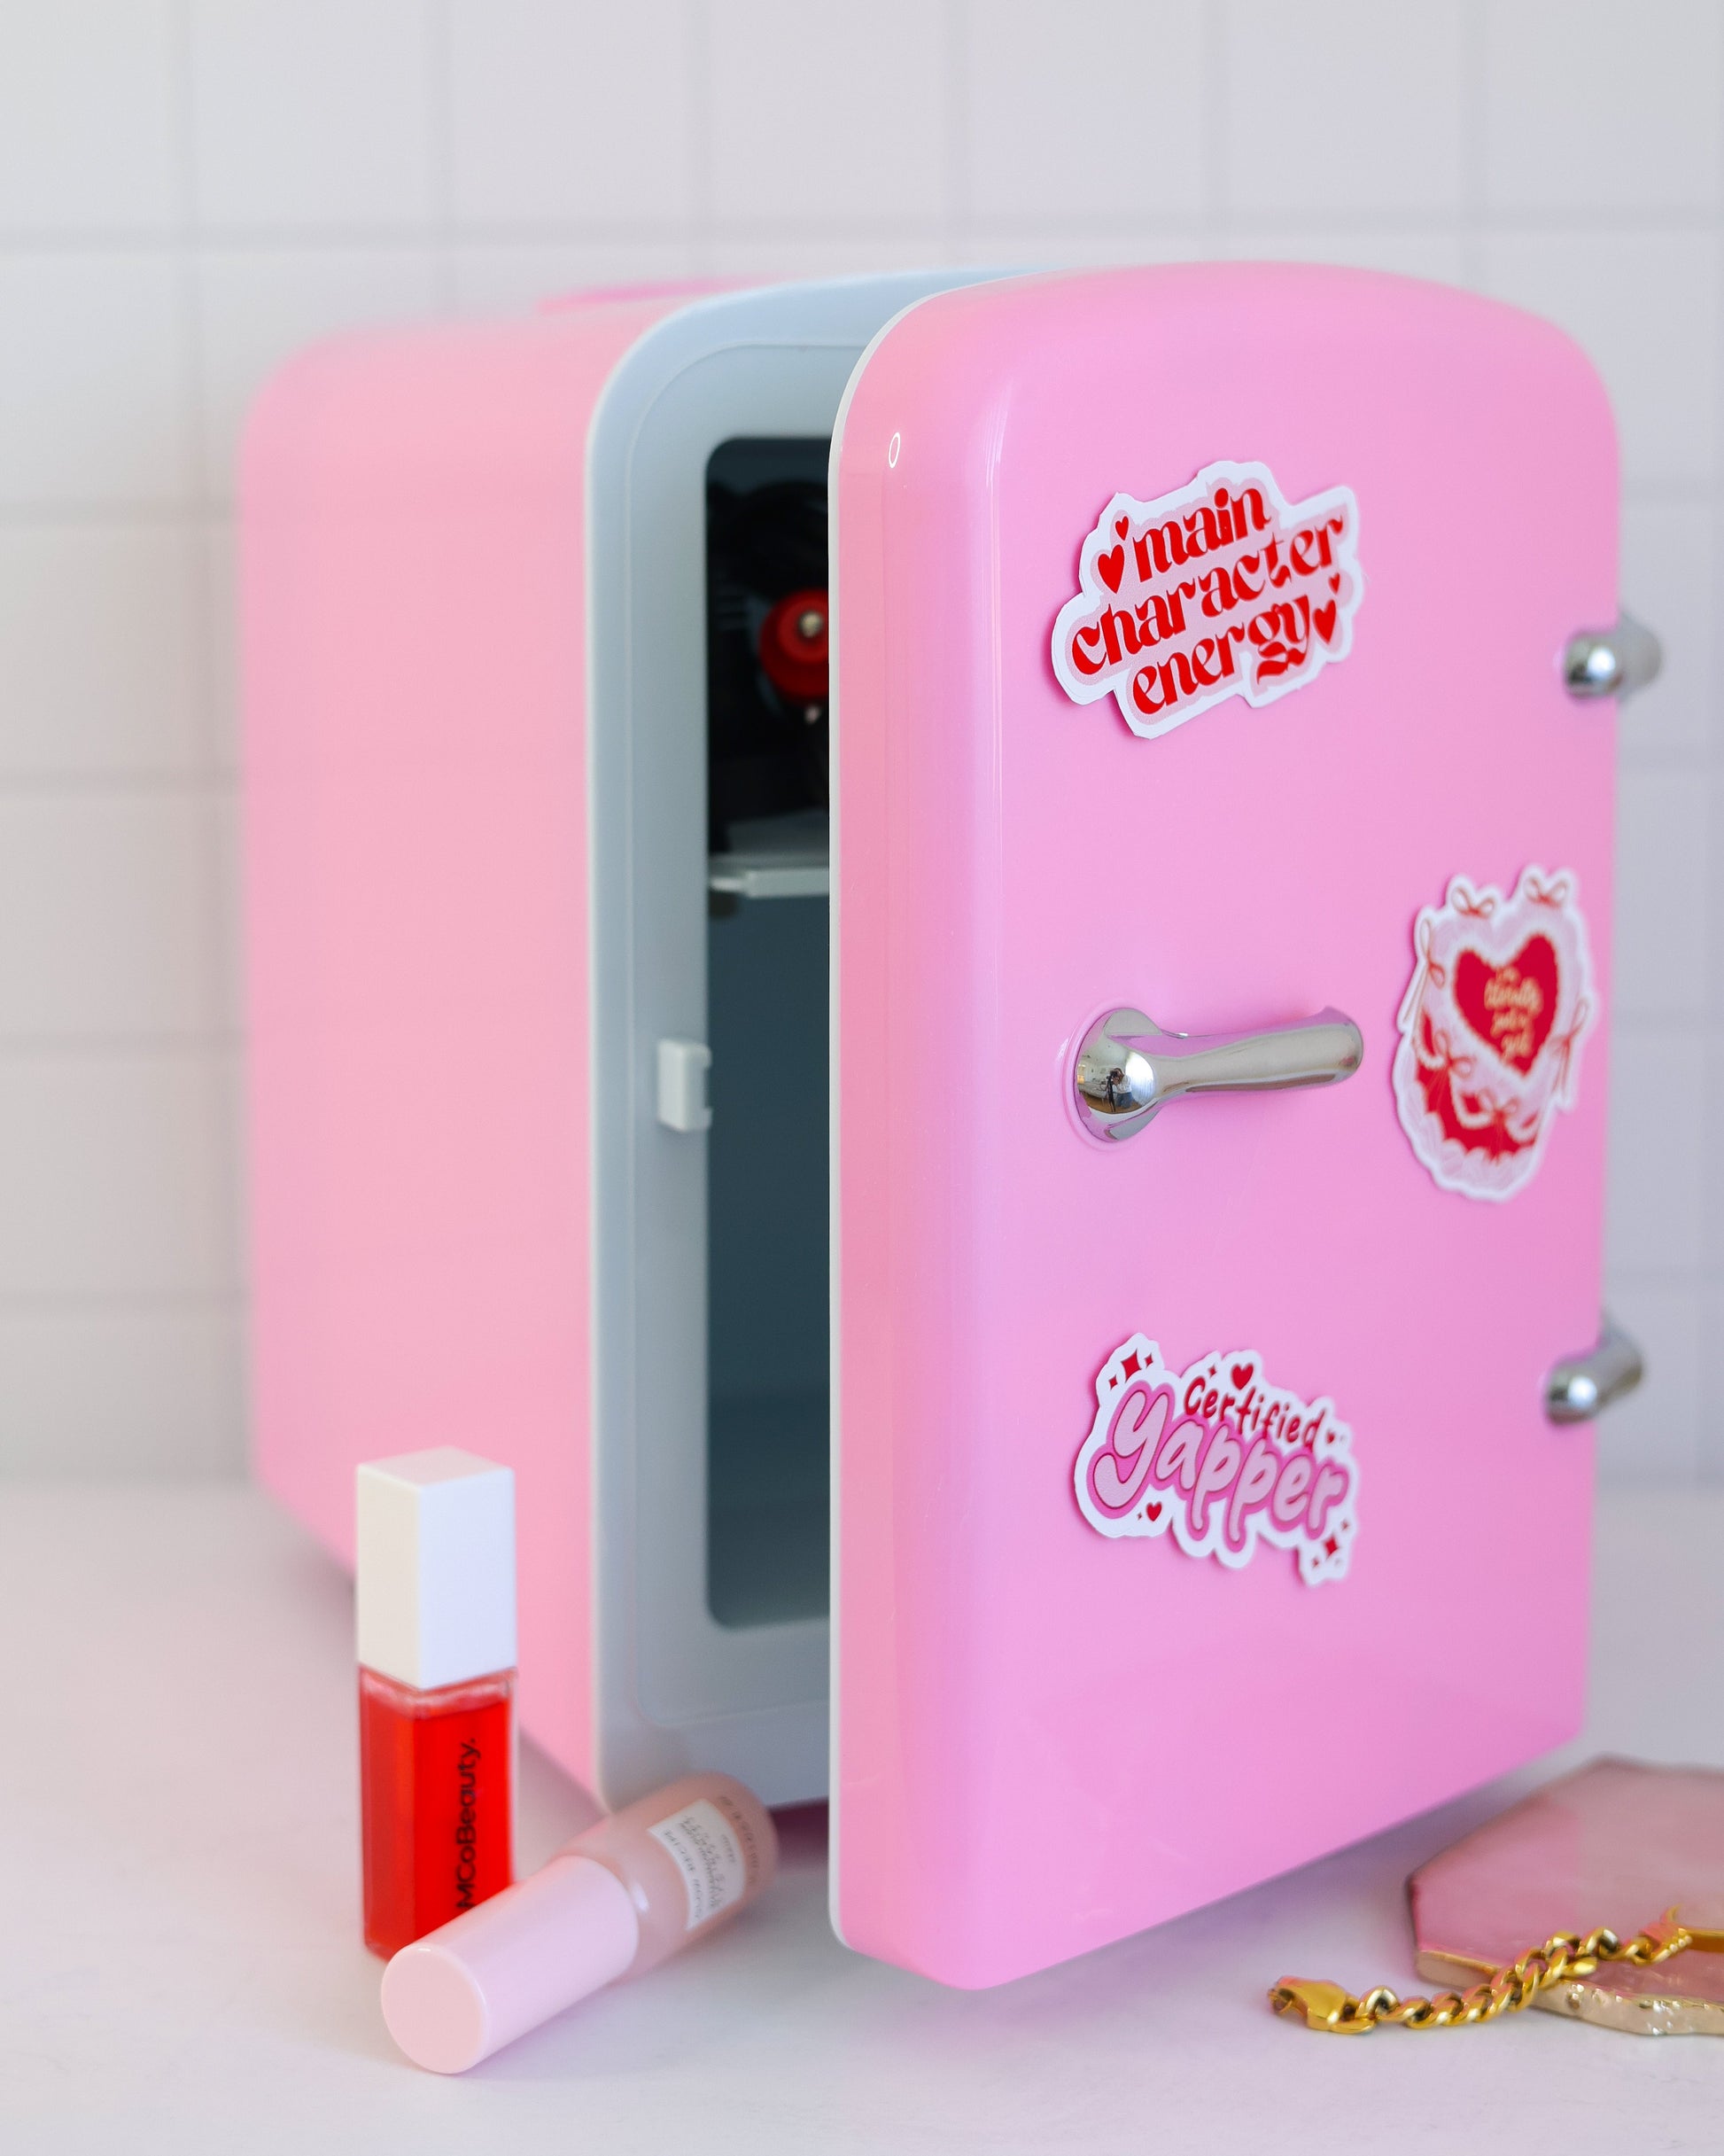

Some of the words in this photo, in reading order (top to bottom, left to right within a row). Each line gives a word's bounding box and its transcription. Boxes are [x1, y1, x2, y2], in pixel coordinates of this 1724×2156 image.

[1132, 487, 1271, 582] main
[1072, 515, 1343, 675] character
[1132, 595, 1310, 714] energy
[1184, 1375, 1325, 1453] Certified
[455, 1738, 481, 1909] MCoBeauty.
